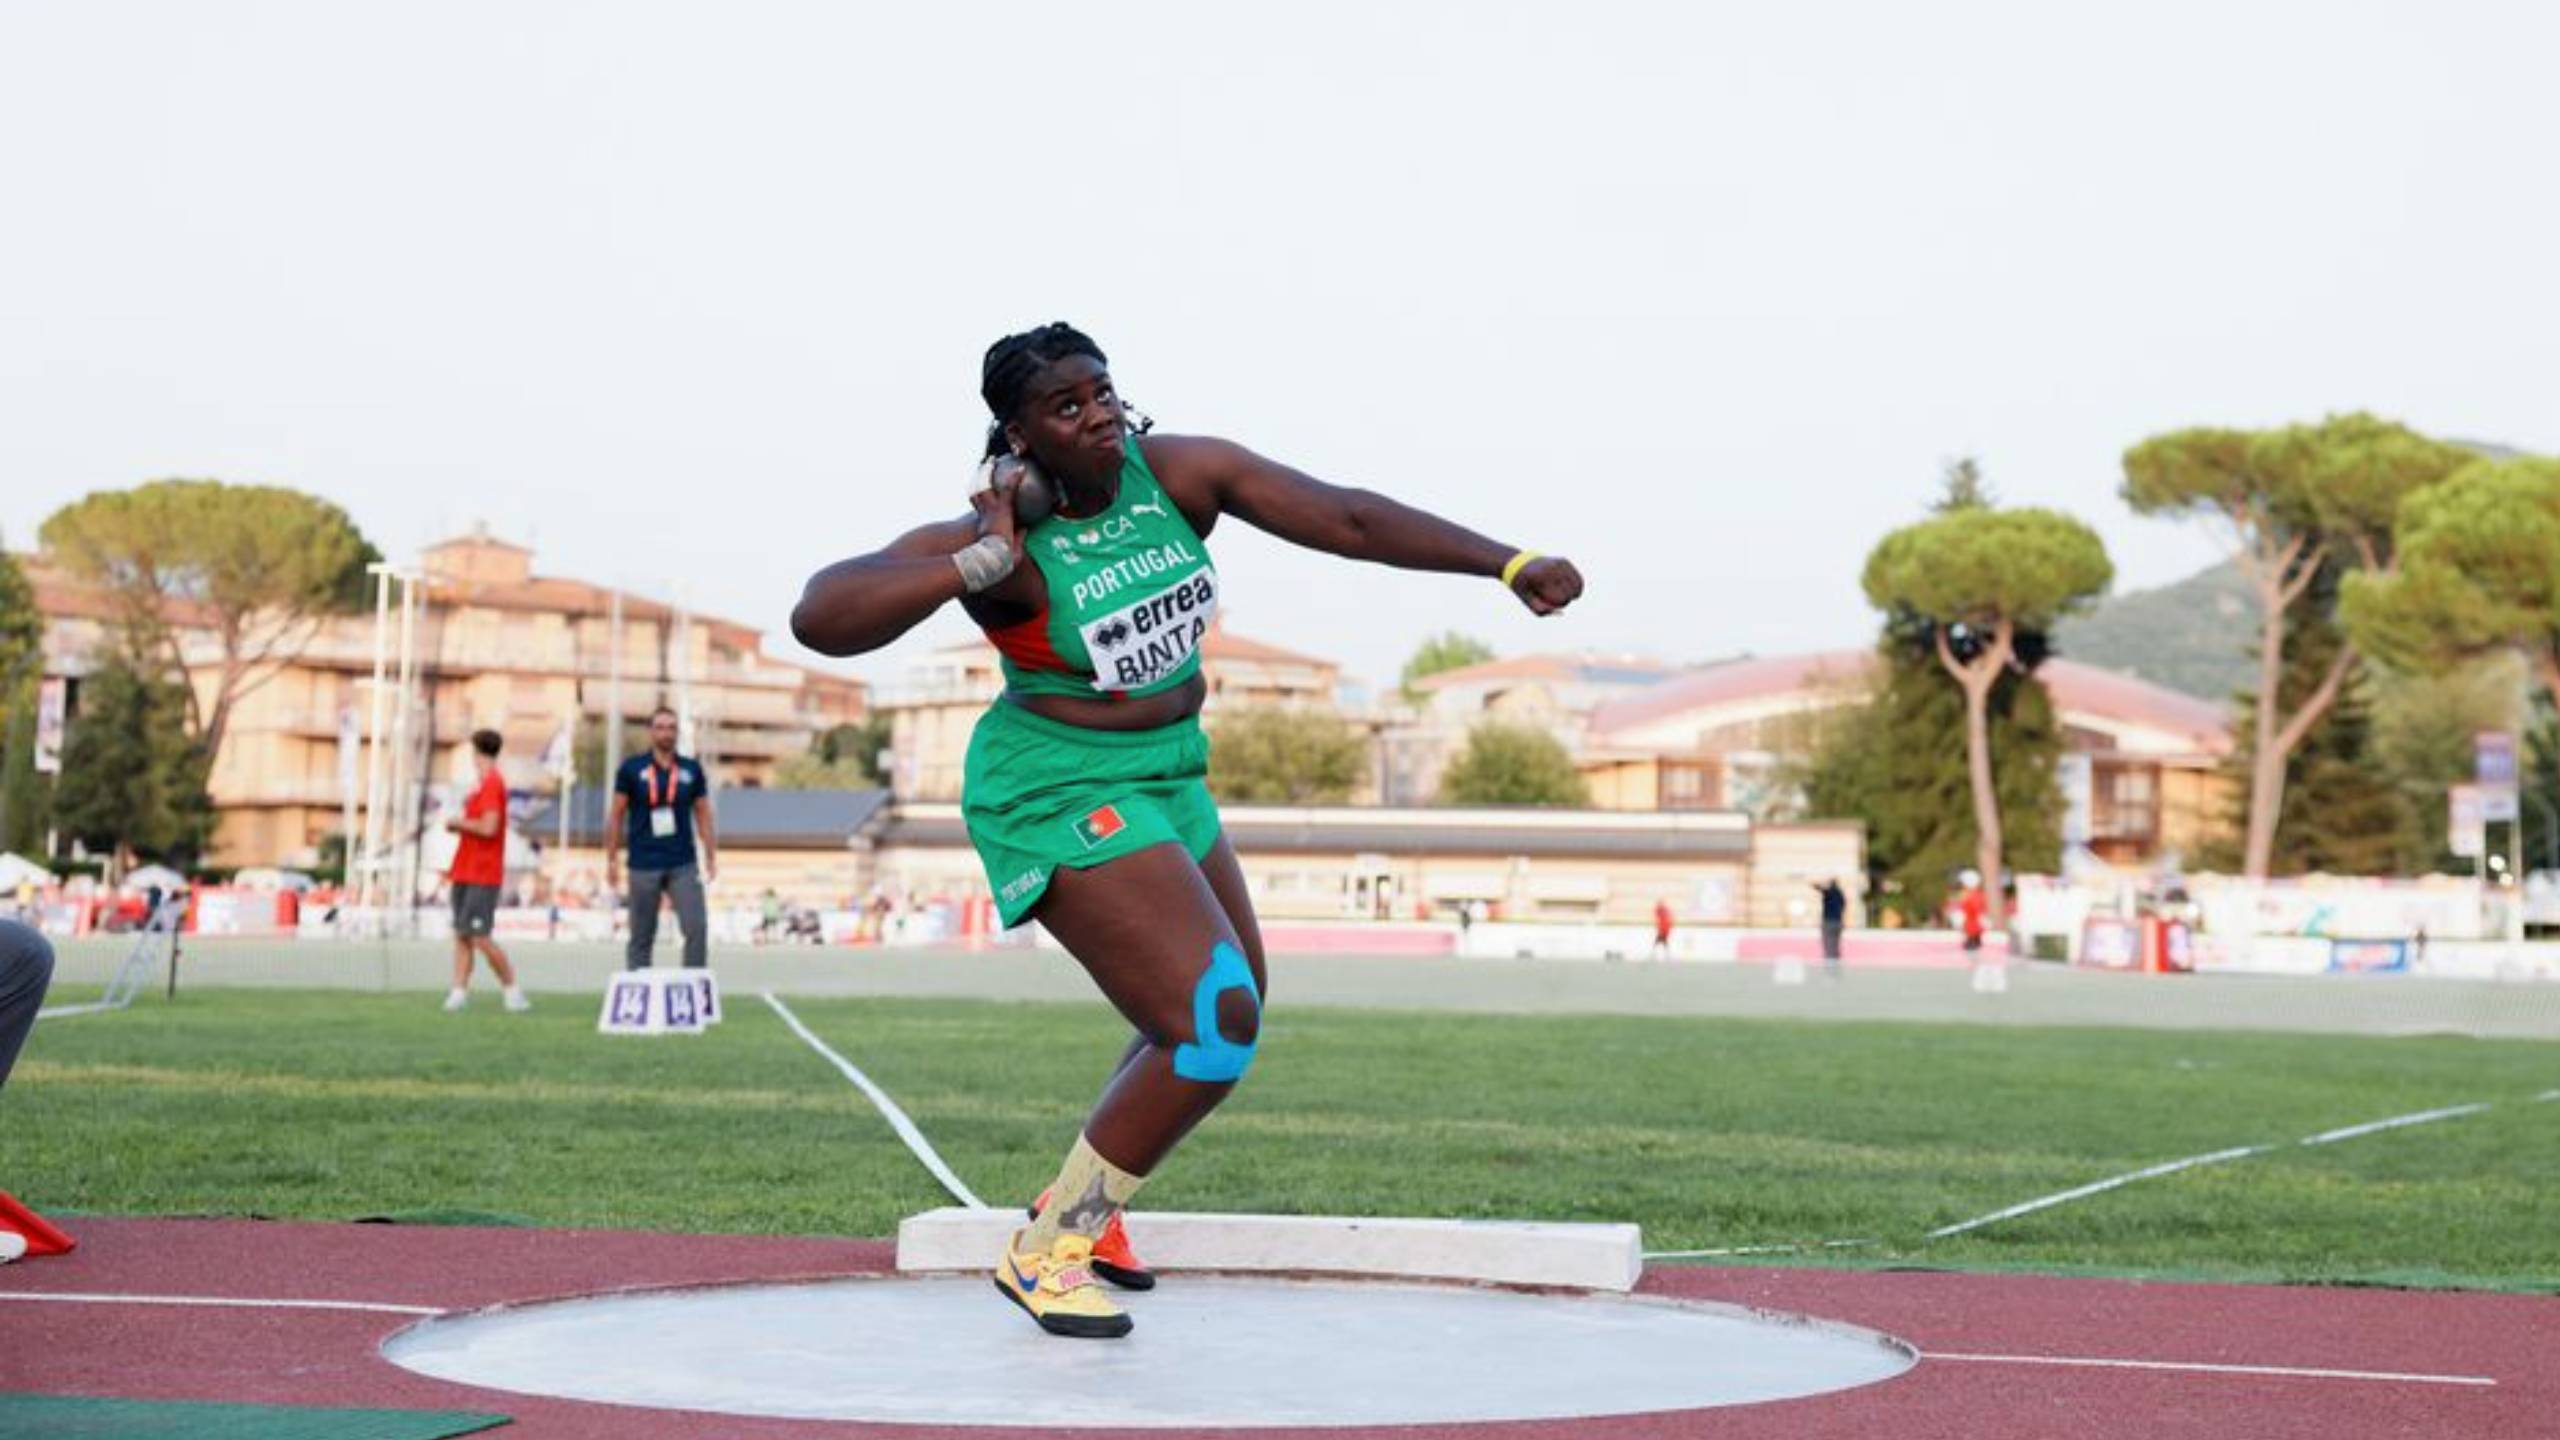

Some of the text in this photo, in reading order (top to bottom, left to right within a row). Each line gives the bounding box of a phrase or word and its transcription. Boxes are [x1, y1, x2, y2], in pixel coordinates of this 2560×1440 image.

[1072, 541, 1196, 608] PORTUGAL
[1132, 575, 1213, 634] errea
[1115, 616, 1205, 684] BINTA
